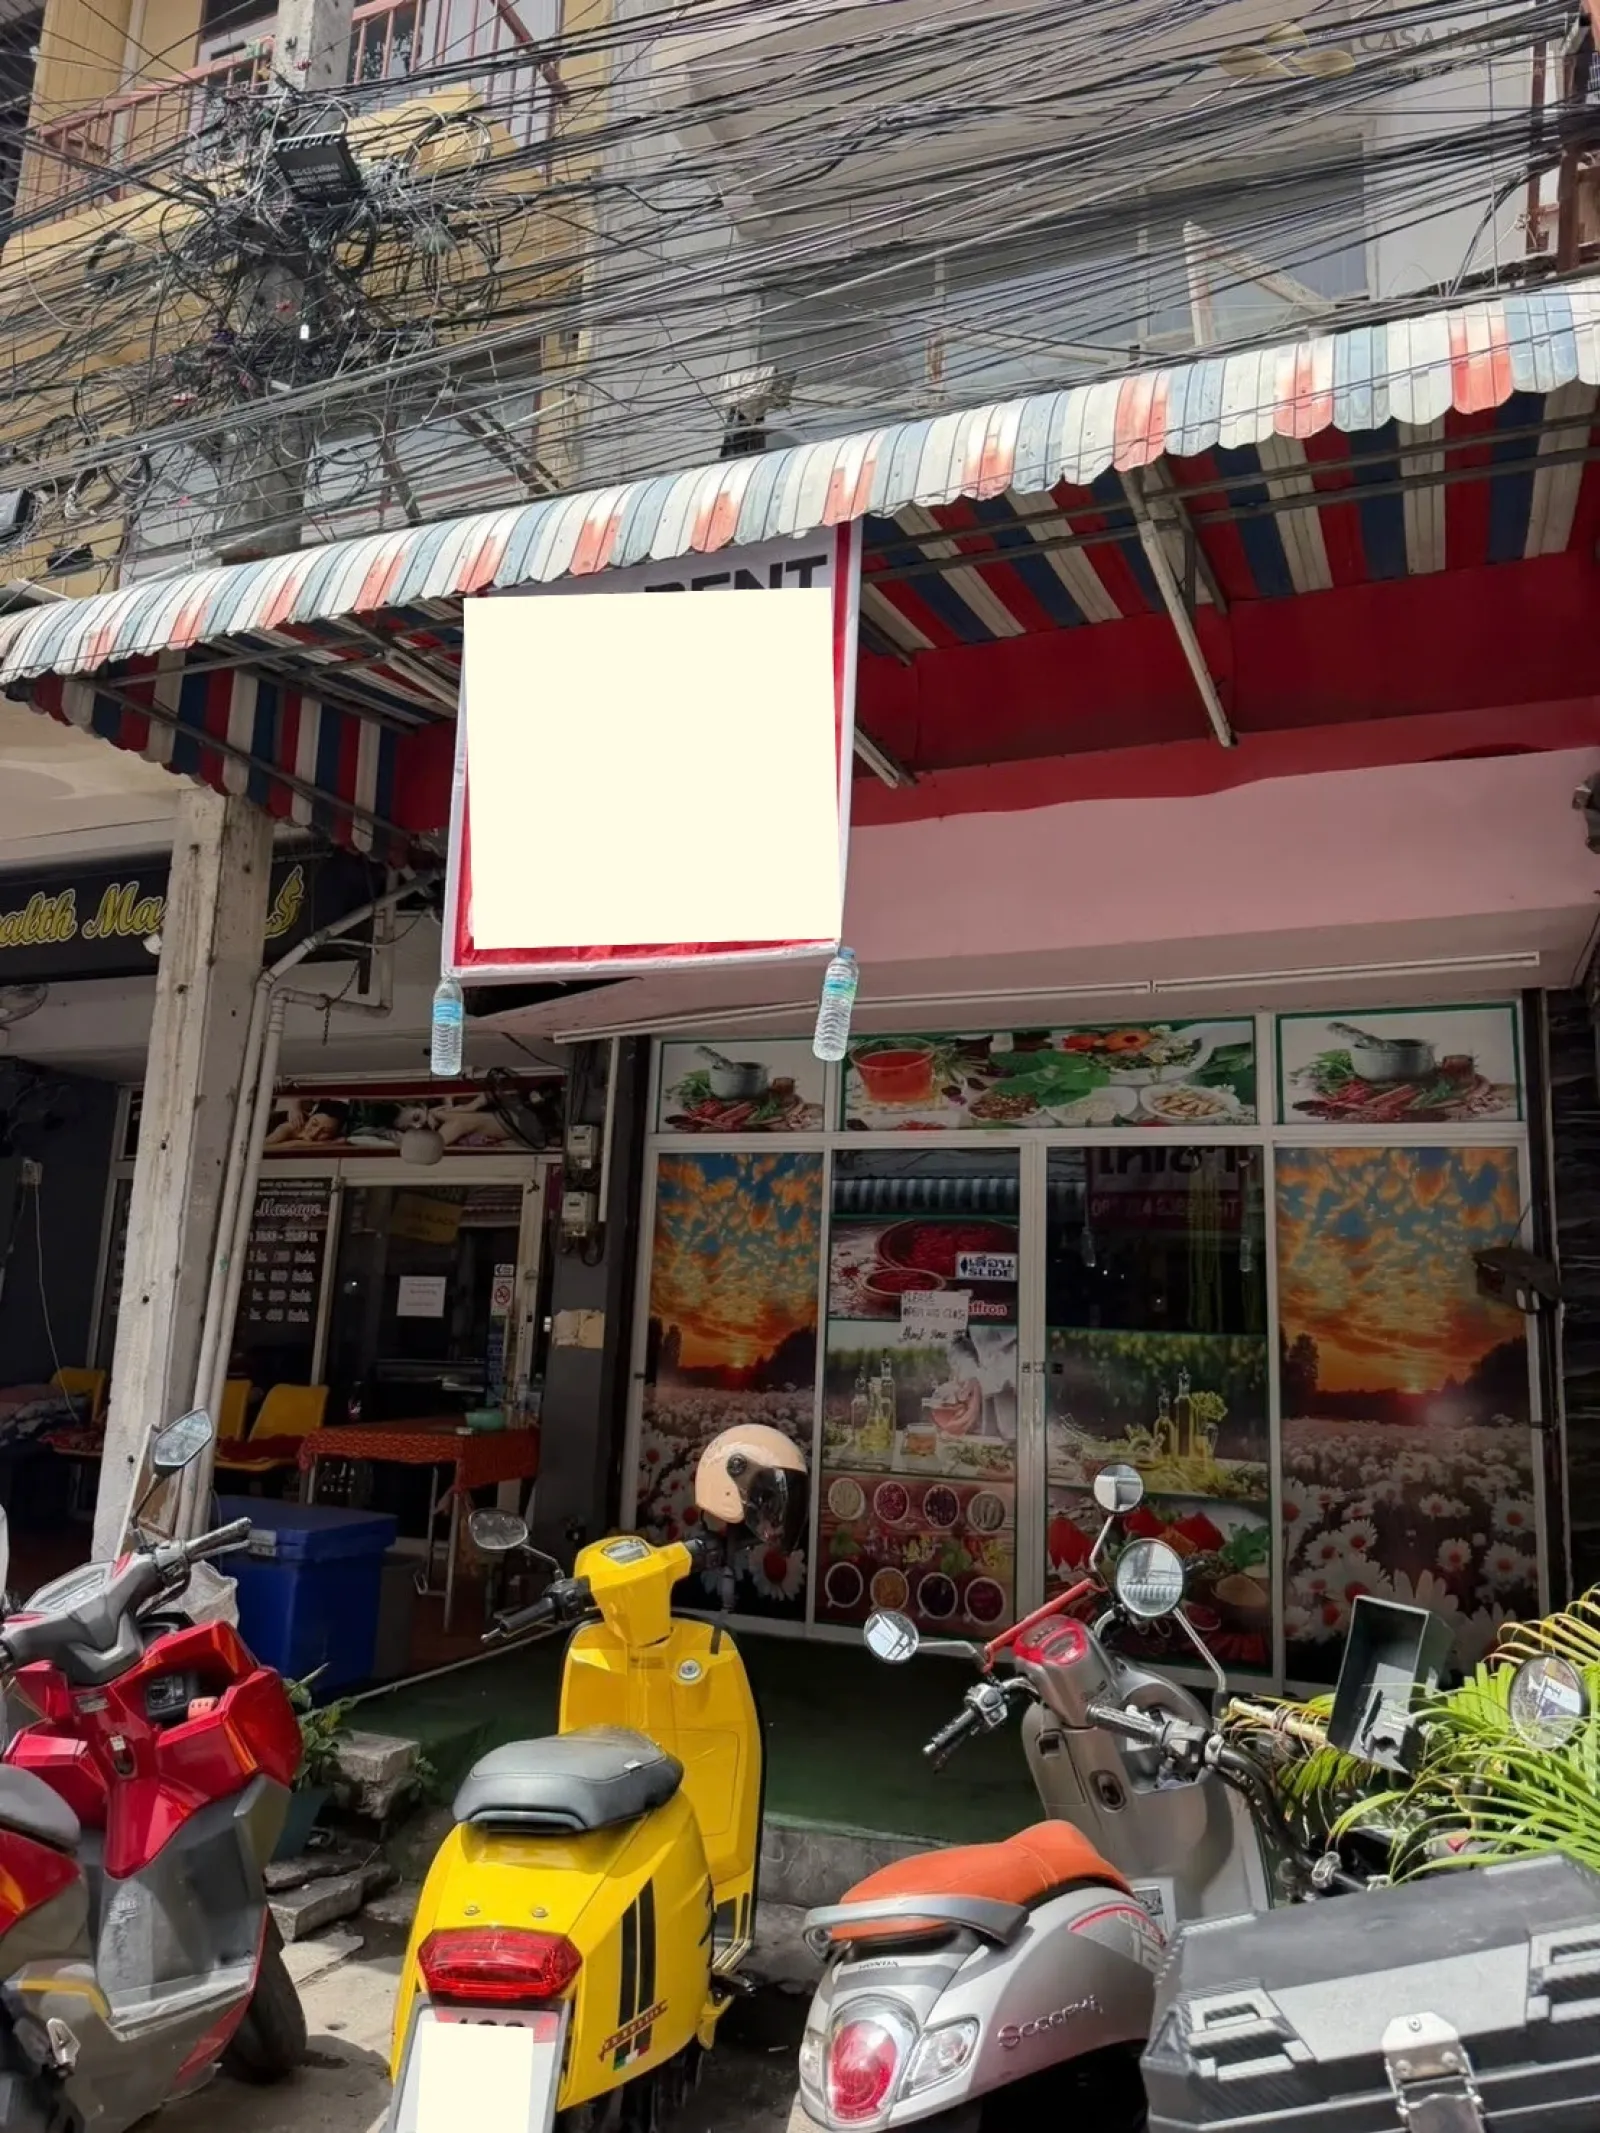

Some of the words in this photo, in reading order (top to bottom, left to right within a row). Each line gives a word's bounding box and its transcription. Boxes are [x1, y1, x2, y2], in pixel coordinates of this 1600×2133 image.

[0, 887, 76, 948] alth
[82, 880, 168, 939] Ma
[968, 1267, 1013, 1278] SLIDE
